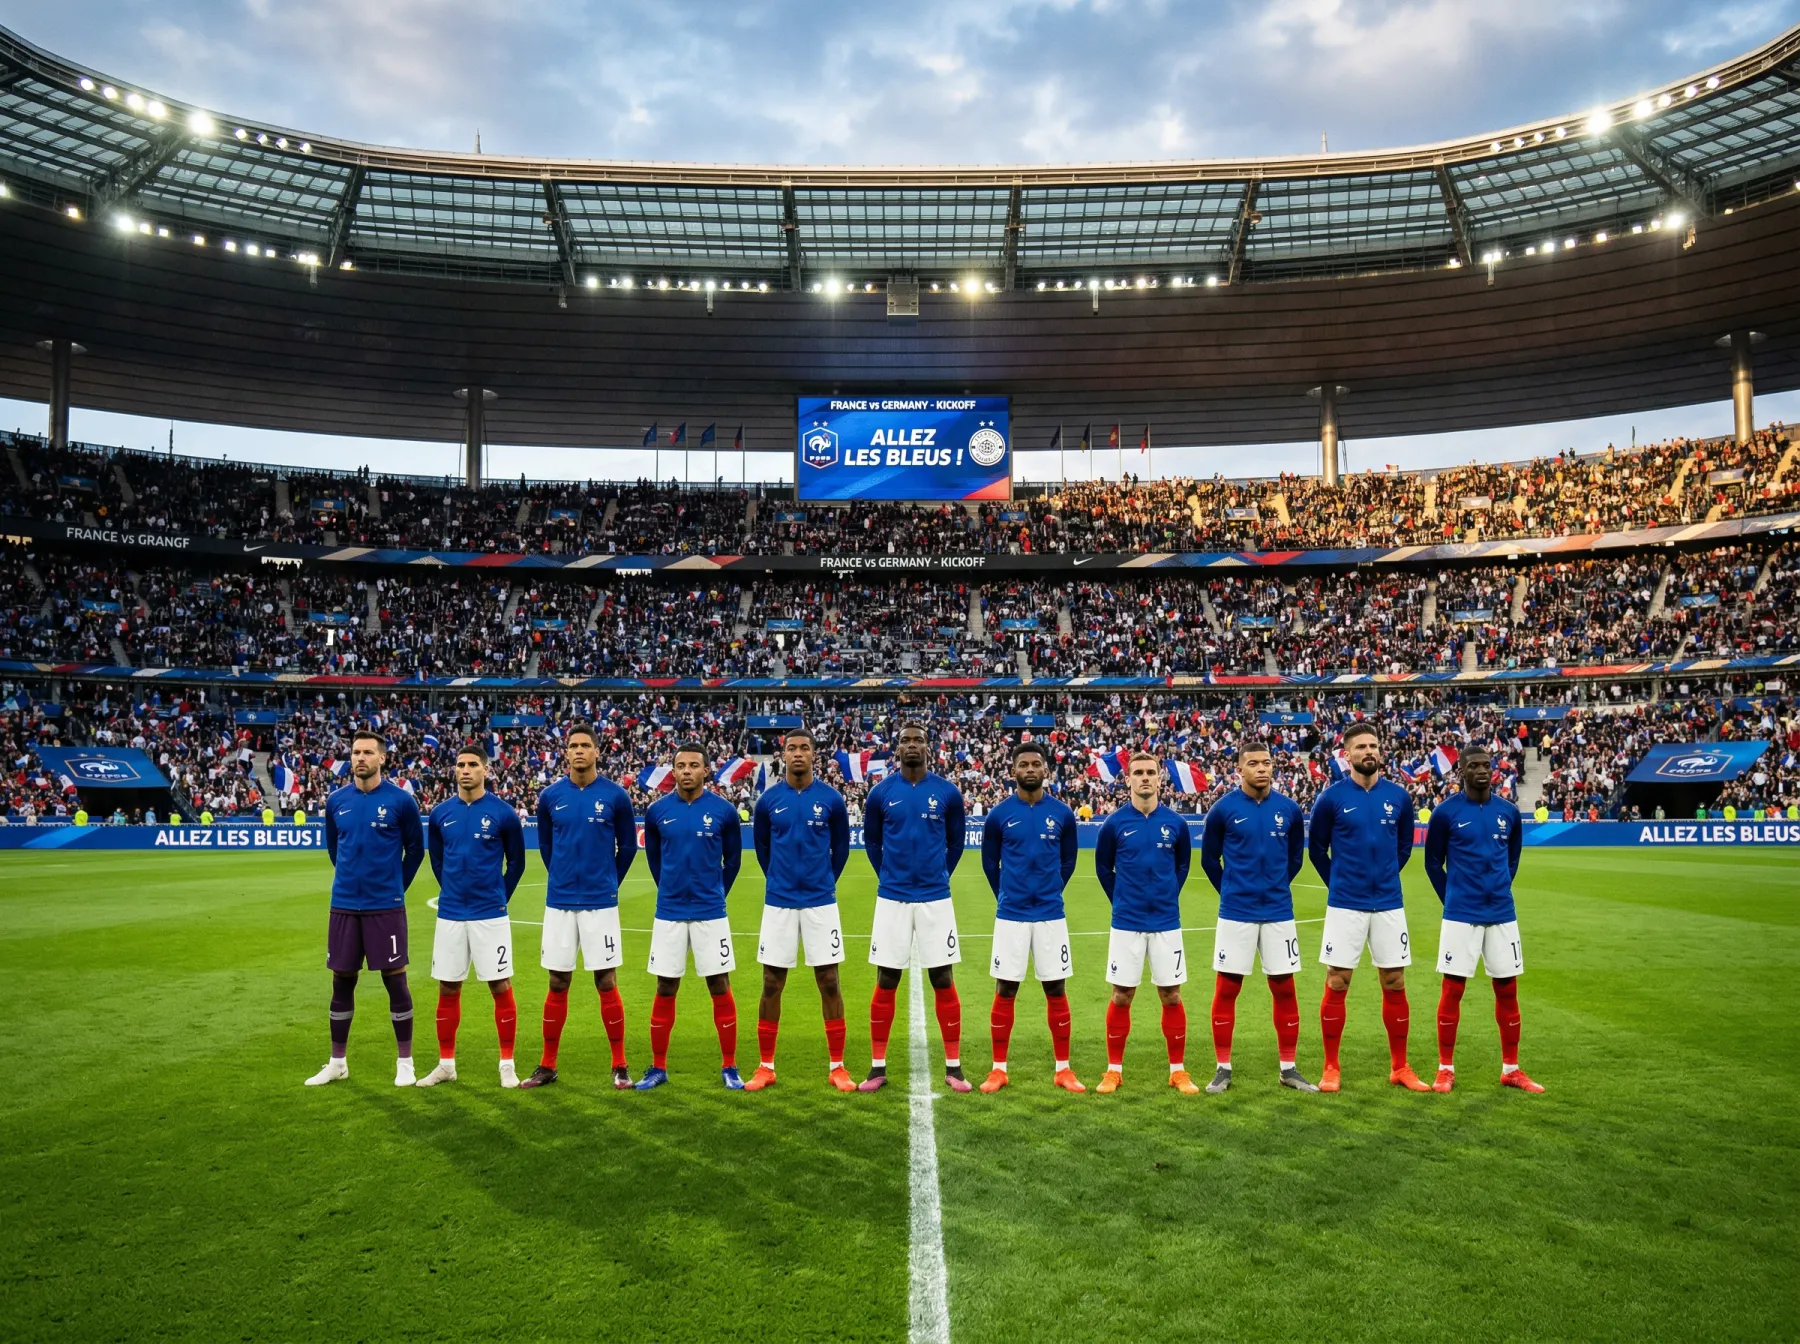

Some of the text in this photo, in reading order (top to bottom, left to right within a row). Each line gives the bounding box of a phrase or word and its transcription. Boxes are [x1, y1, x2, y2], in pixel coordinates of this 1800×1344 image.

[830, 400, 868, 410] FRANCE
[881, 400, 928, 410] GERMANY
[936, 400, 976, 410] KICKOFF
[870, 428, 937, 446] ALLEZ
[844, 448, 881, 466] LES
[885, 448, 952, 466] BLEUS
[66, 527, 118, 543] FRANCE
[820, 557, 862, 568] FRANCE
[878, 556, 931, 568] GERMANY
[941, 556, 986, 567] KICKOFF
[155, 829, 213, 846] ALLEZ
[217, 829, 249, 846] LES
[254, 829, 312, 846] BLEUS
[1639, 826, 1800, 842] ALLEZ LES BLEUS
[389, 935, 397, 954] 1
[604, 935, 615, 953] 4
[719, 938, 730, 958] 5
[830, 929, 840, 949] 3
[946, 929, 956, 949] 6
[1285, 938, 1299, 959] 10
[1400, 932, 1408, 951] 9
[496, 945, 508, 965] 2
[1060, 944, 1069, 964] 8
[1173, 949, 1182, 971] 7
